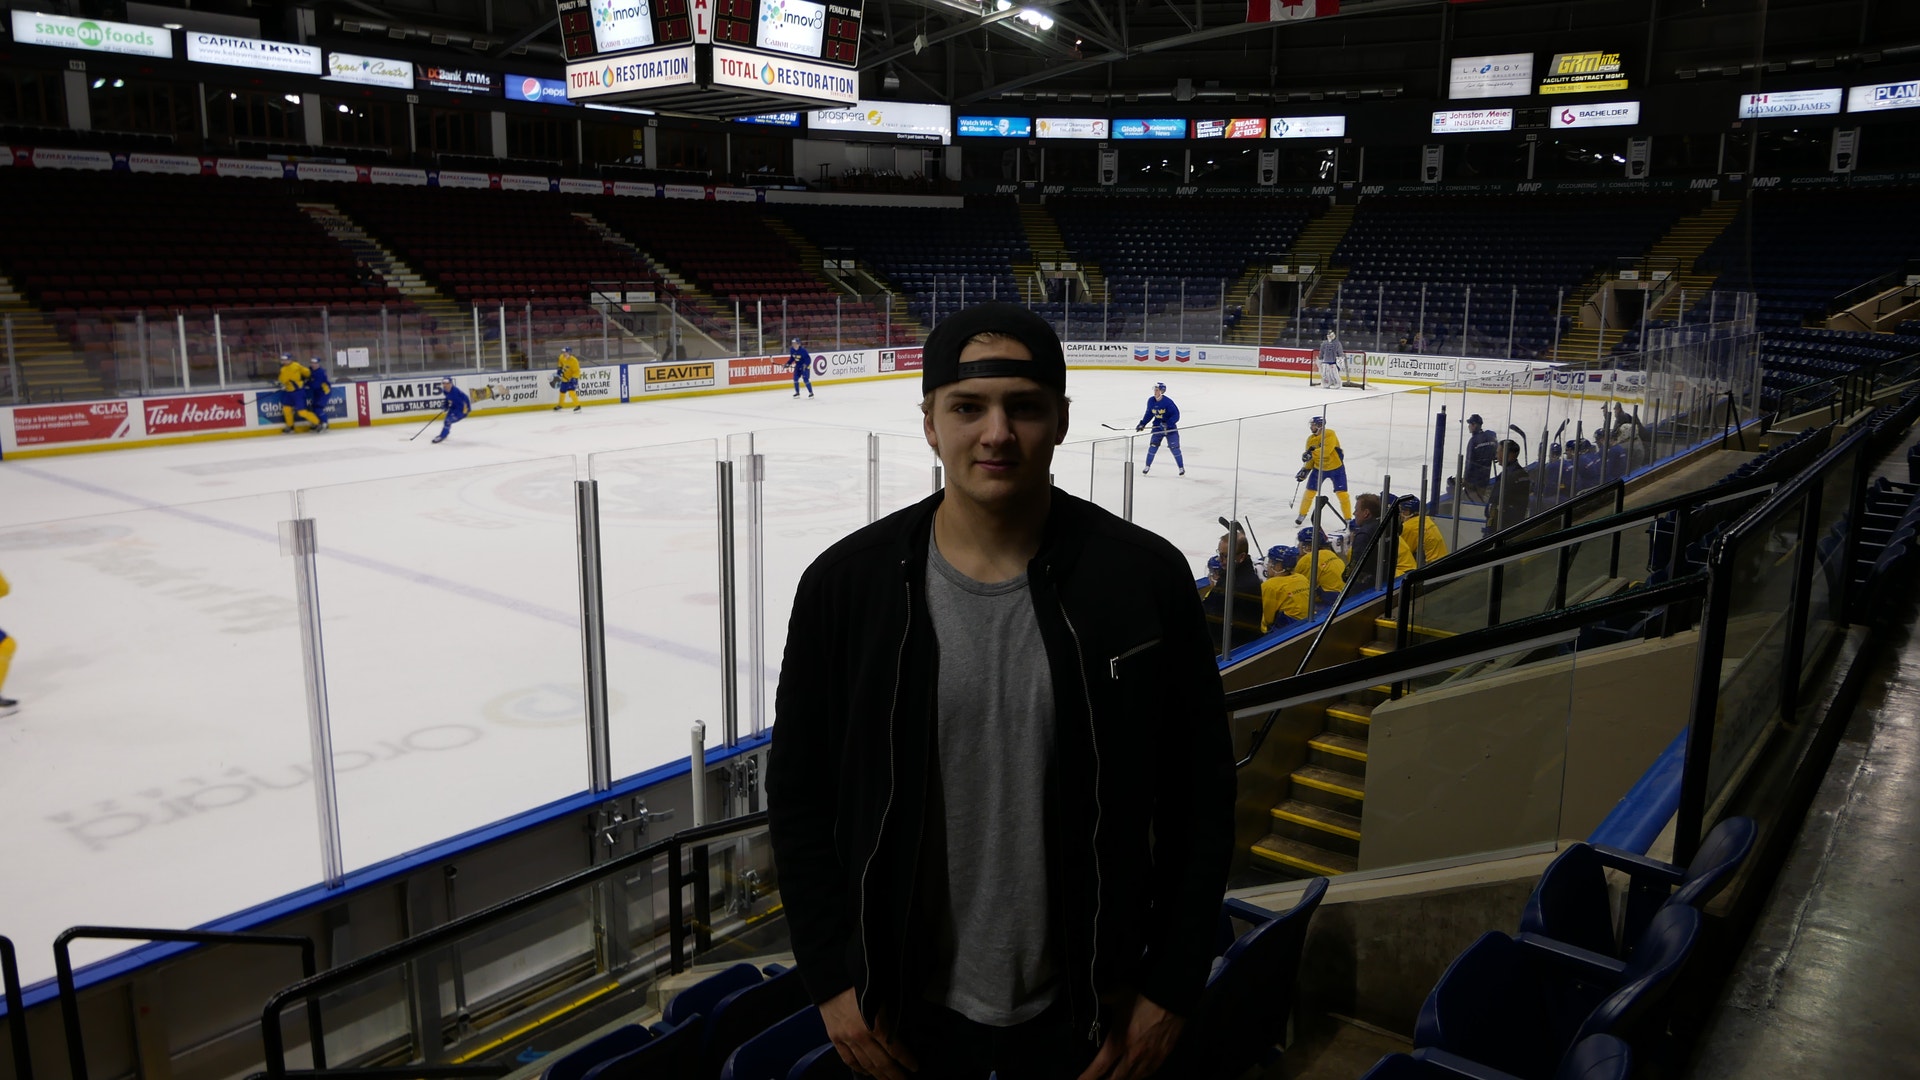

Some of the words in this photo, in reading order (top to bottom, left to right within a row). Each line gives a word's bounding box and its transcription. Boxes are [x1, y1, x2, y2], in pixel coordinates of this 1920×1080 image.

[559, 1, 577, 11] PENALTY
[829, 4, 850, 17] PENALTY
[783, 9, 823, 30] innov8
[35, 22, 76, 38] save
[104, 27, 155, 46] foods
[198, 35, 256, 50] CAPITAL
[600, 40, 621, 50] Canon
[622, 35, 651, 46] SOLUTIONS
[764, 37, 789, 49] Canon
[789, 43, 816, 54] COPIERS
[465, 72, 491, 85] ATMs
[571, 70, 601, 89] TOTAL
[616, 57, 689, 83] RESTORATION
[720, 58, 758, 80] TOTAL
[777, 67, 854, 95] RESTORATION
[1570, 74, 1605, 83] CONTRACT
[1605, 73, 1625, 81] MGMT
[542, 88, 565, 98] pepsi
[1876, 84, 1918, 101] PLAN
[1579, 109, 1629, 118] BACHELDER
[1747, 103, 1797, 115] RAYMOND
[1797, 101, 1832, 112] JAMES
[817, 109, 865, 123] prospera
[1449, 111, 1484, 121] Johnston
[1454, 118, 1505, 127] INSURANCE
[1121, 125, 1143, 133] Global
[1516, 182, 1542, 193] MNP
[1557, 182, 1598, 190] ACCOUNTING
[1689, 178, 1719, 189] MNP
[1751, 176, 1782, 188] MNP
[1791, 176, 1839, 184] ACCOUNTING
[995, 184, 1018, 194] MNP
[1043, 185, 1065, 194] MNP
[1175, 186, 1198, 196] MNP
[1311, 186, 1334, 195] MNP
[1360, 185, 1384, 195] MNP
[1066, 344, 1097, 352] CAPITAL
[831, 353, 865, 366] COAST
[1266, 354, 1296, 362] Boston
[730, 366, 747, 378] THE
[748, 364, 772, 377] HOME
[773, 363, 794, 375] DEPO
[832, 367, 849, 376] capri
[849, 365, 866, 374] hotel
[1389, 357, 1456, 372] MacDermott's
[488, 376, 500, 384] long
[500, 374, 519, 384] lasting
[520, 374, 538, 383] energy
[599, 370, 611, 381] Fly
[647, 365, 712, 381] LEAVITT
[1412, 370, 1440, 378] Bernard
[383, 383, 414, 401] AM
[500, 391, 511, 401] so
[512, 389, 539, 403] good!
[359, 384, 368, 416] CCM
[96, 403, 127, 416] CLAC
[386, 403, 404, 413] NEWS
[409, 401, 425, 410] TALK
[147, 404, 179, 426] Tim
[181, 402, 243, 424] Hortons
